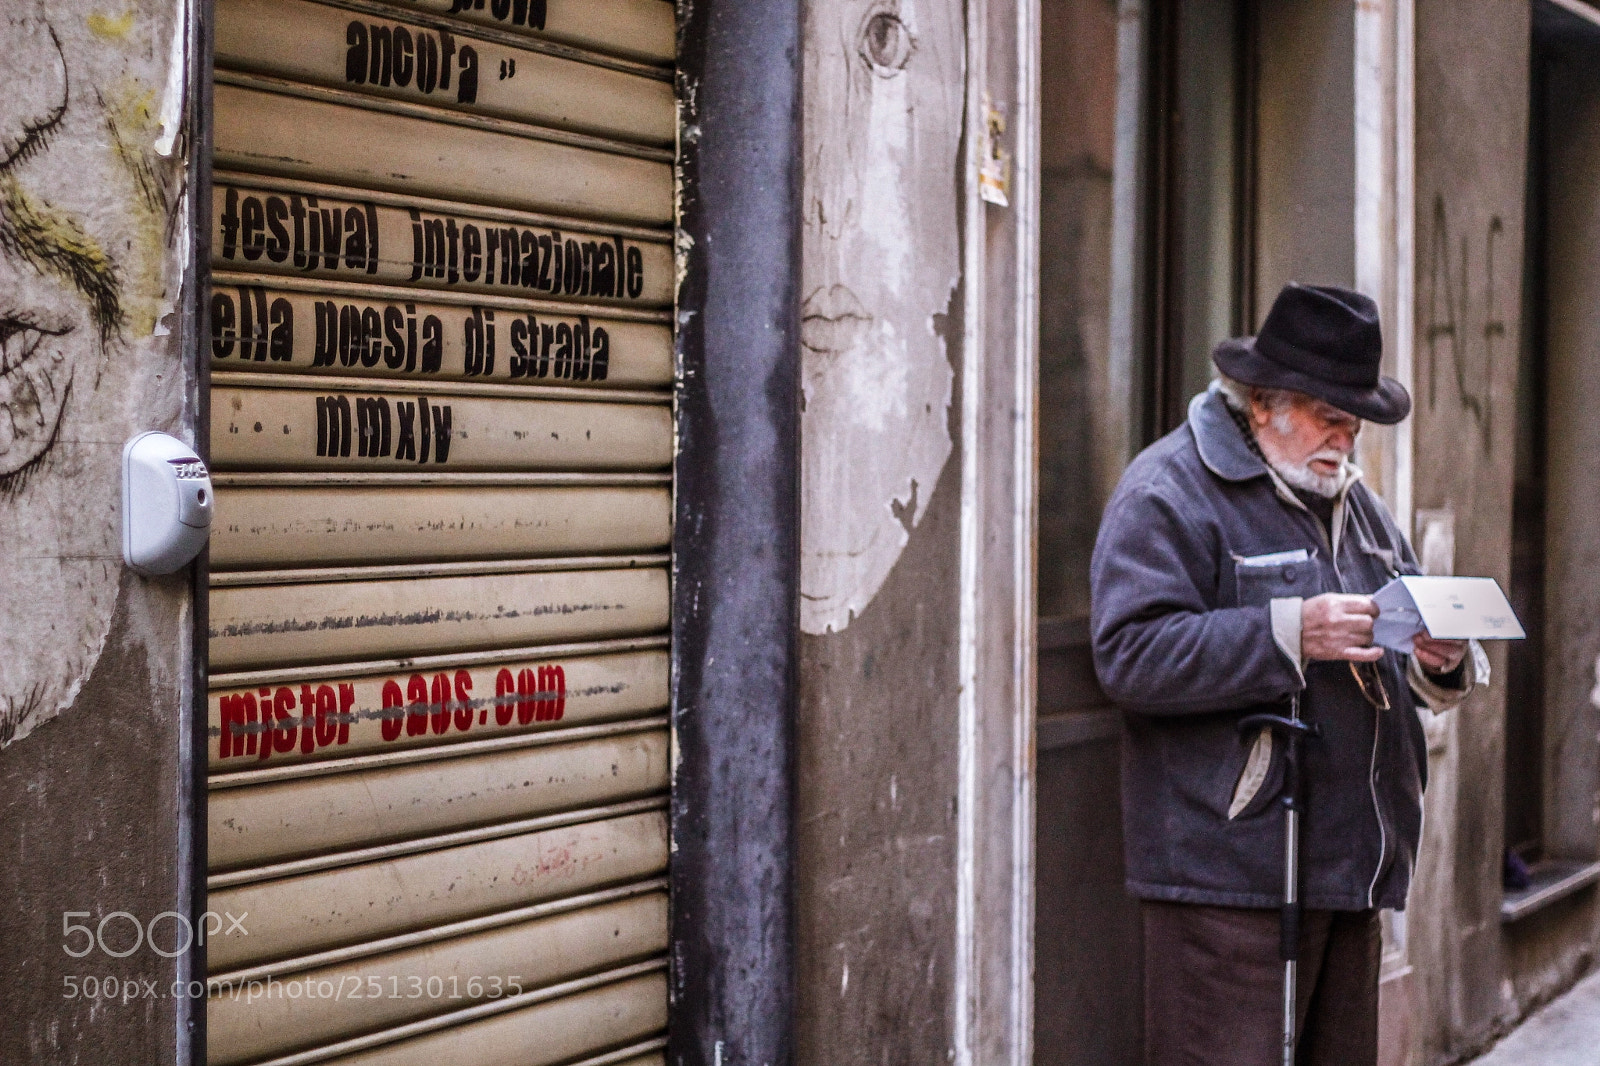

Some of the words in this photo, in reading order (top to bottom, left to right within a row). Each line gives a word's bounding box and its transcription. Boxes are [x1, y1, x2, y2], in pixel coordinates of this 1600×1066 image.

[346, 20, 478, 104] ancora
[221, 188, 379, 275] festival
[409, 208, 643, 299] internazionale
[312, 302, 443, 373] poesia
[464, 305, 496, 376] di
[510, 314, 609, 381] strada
[316, 396, 452, 464] mmxiv
[219, 683, 355, 760] mister
